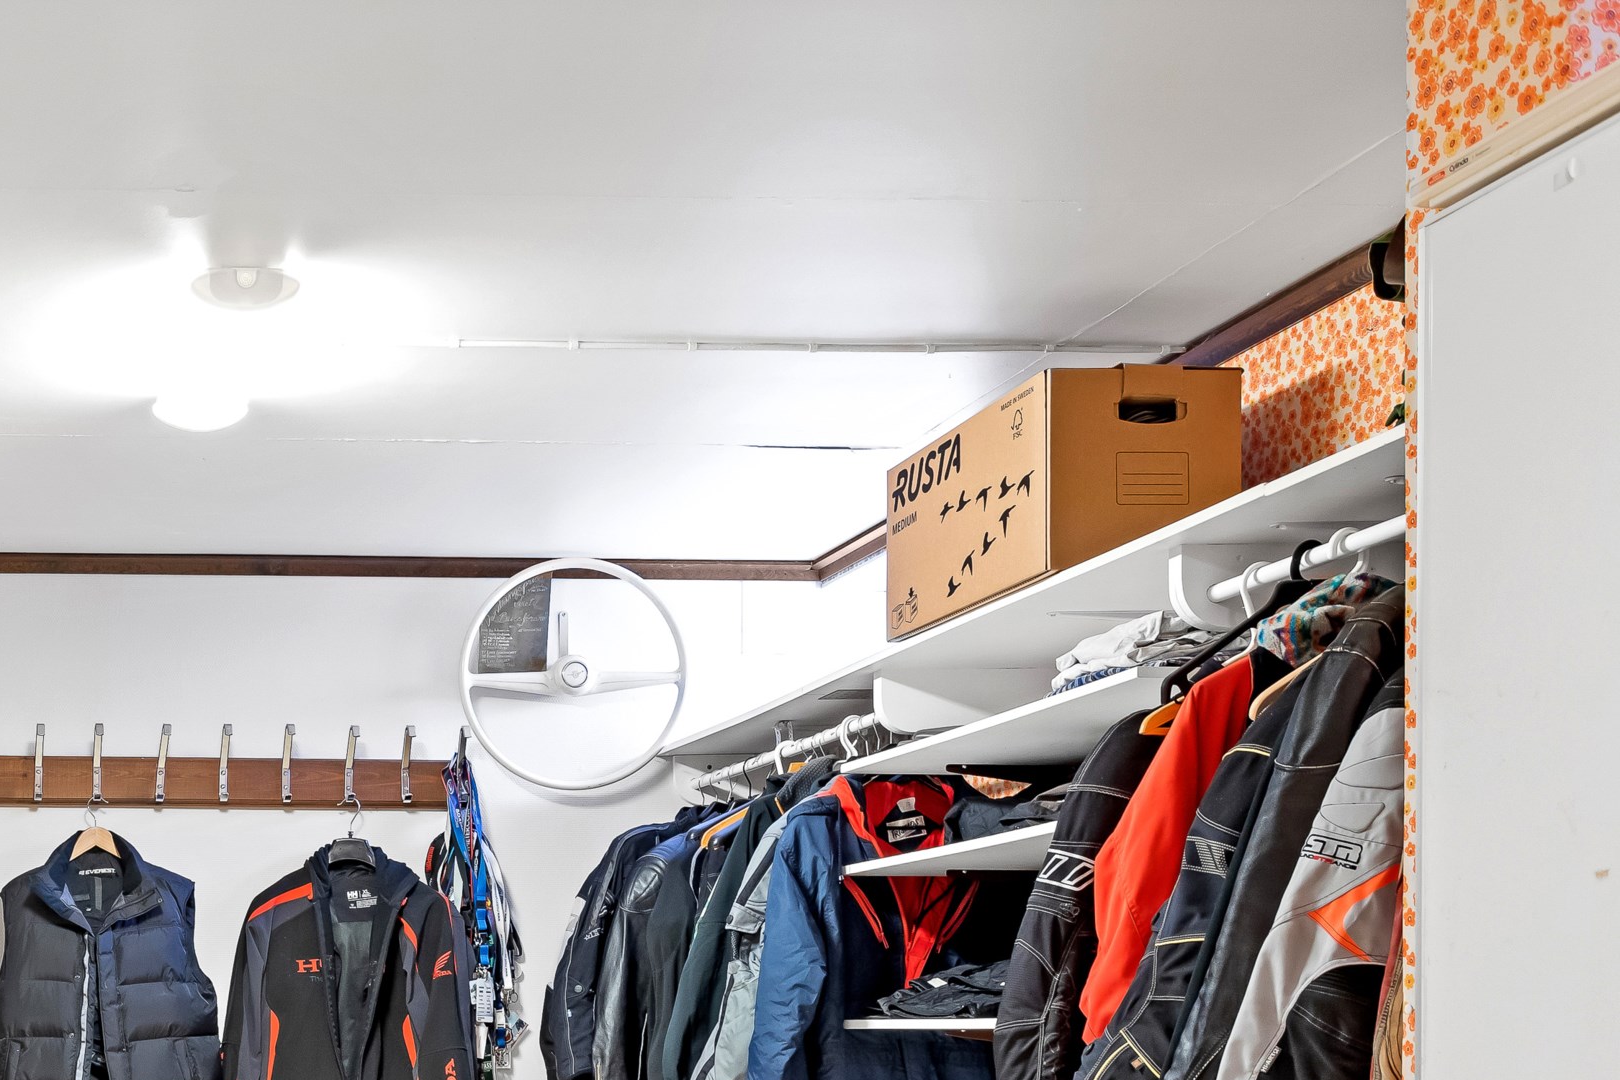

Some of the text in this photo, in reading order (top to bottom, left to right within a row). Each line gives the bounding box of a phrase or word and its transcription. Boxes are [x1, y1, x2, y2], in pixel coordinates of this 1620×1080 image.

[1000, 399, 1012, 411] MADE
[1017, 386, 1035, 402] SWEDEN
[891, 433, 961, 513] RUSTA
[891, 510, 918, 535] MEDIUM
[85, 867, 116, 875] EVEREST
[346, 890, 359, 899] HH
